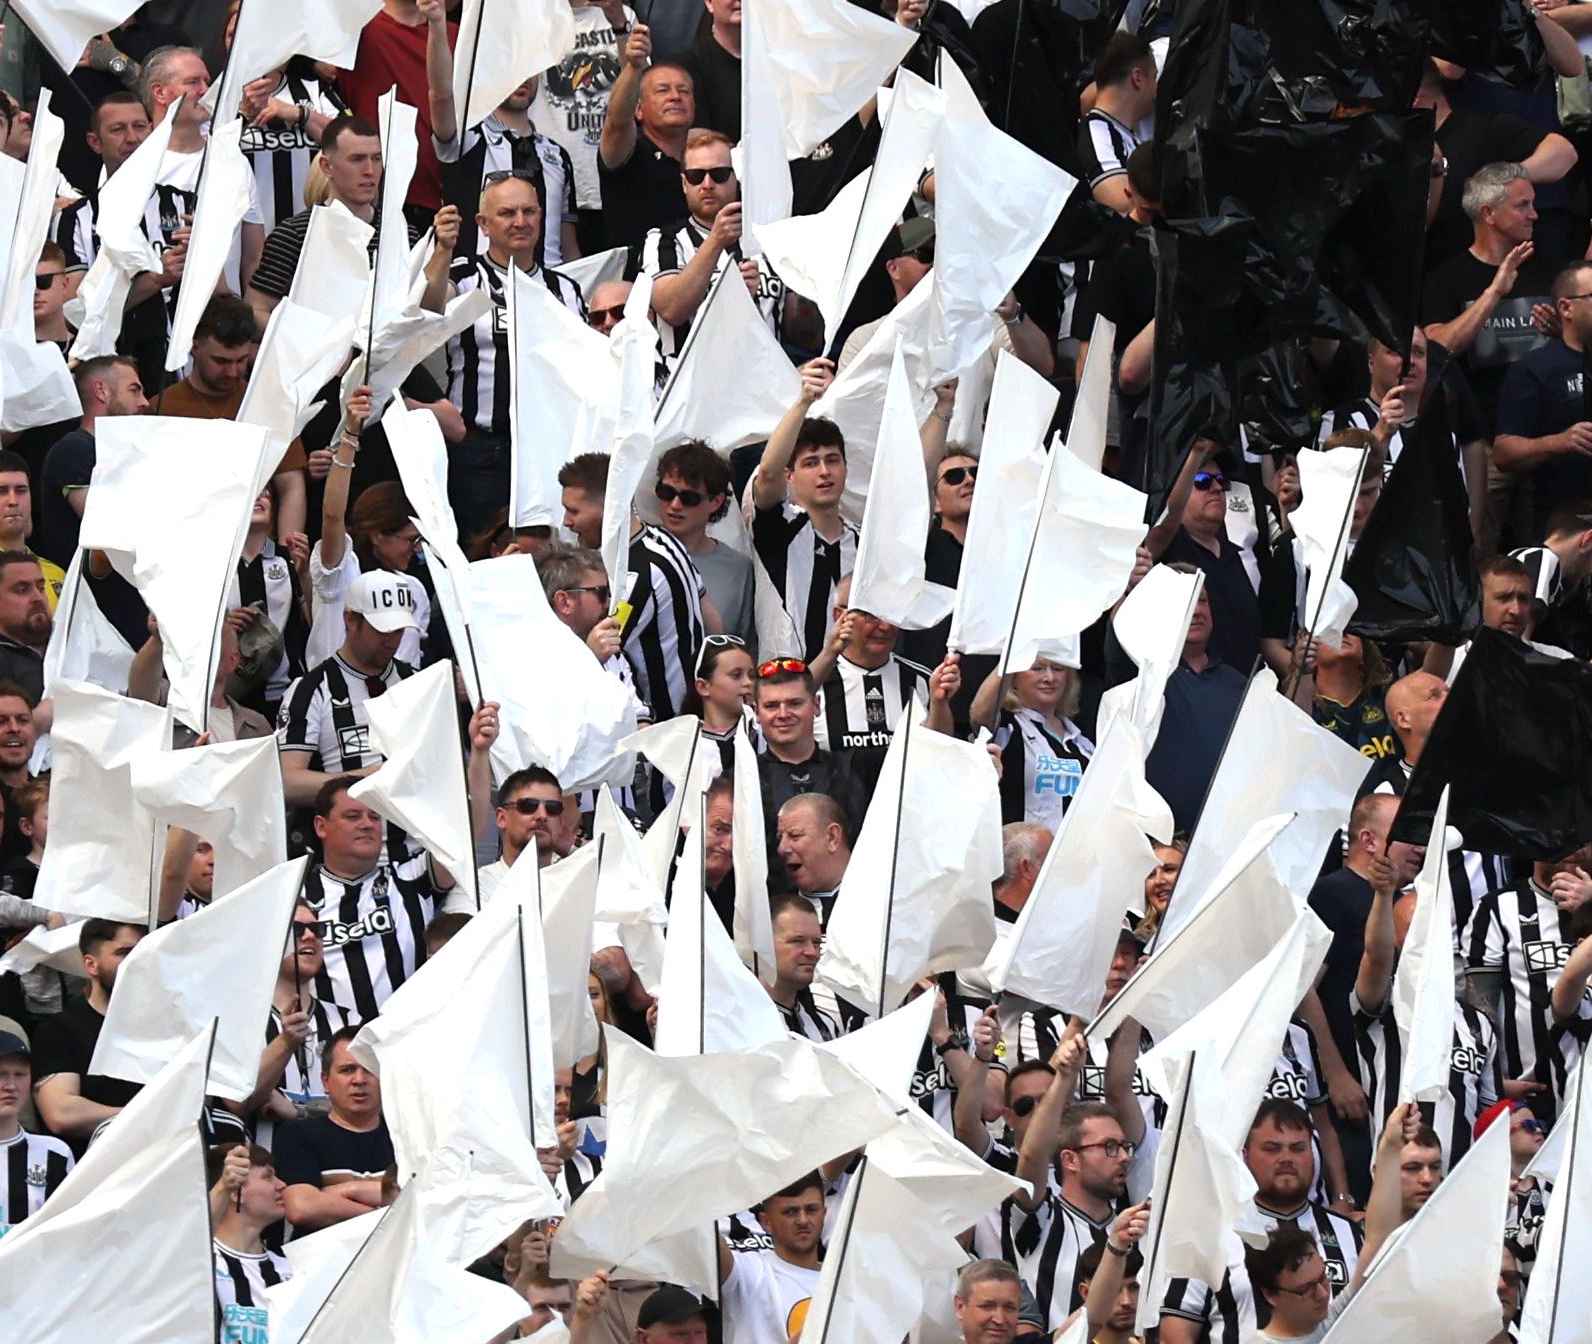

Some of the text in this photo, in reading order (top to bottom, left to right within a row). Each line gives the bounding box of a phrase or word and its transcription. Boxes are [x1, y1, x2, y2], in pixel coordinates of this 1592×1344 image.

[843, 731, 892, 747] north
[1359, 735, 1395, 759] ela
[334, 910, 392, 943] sela
